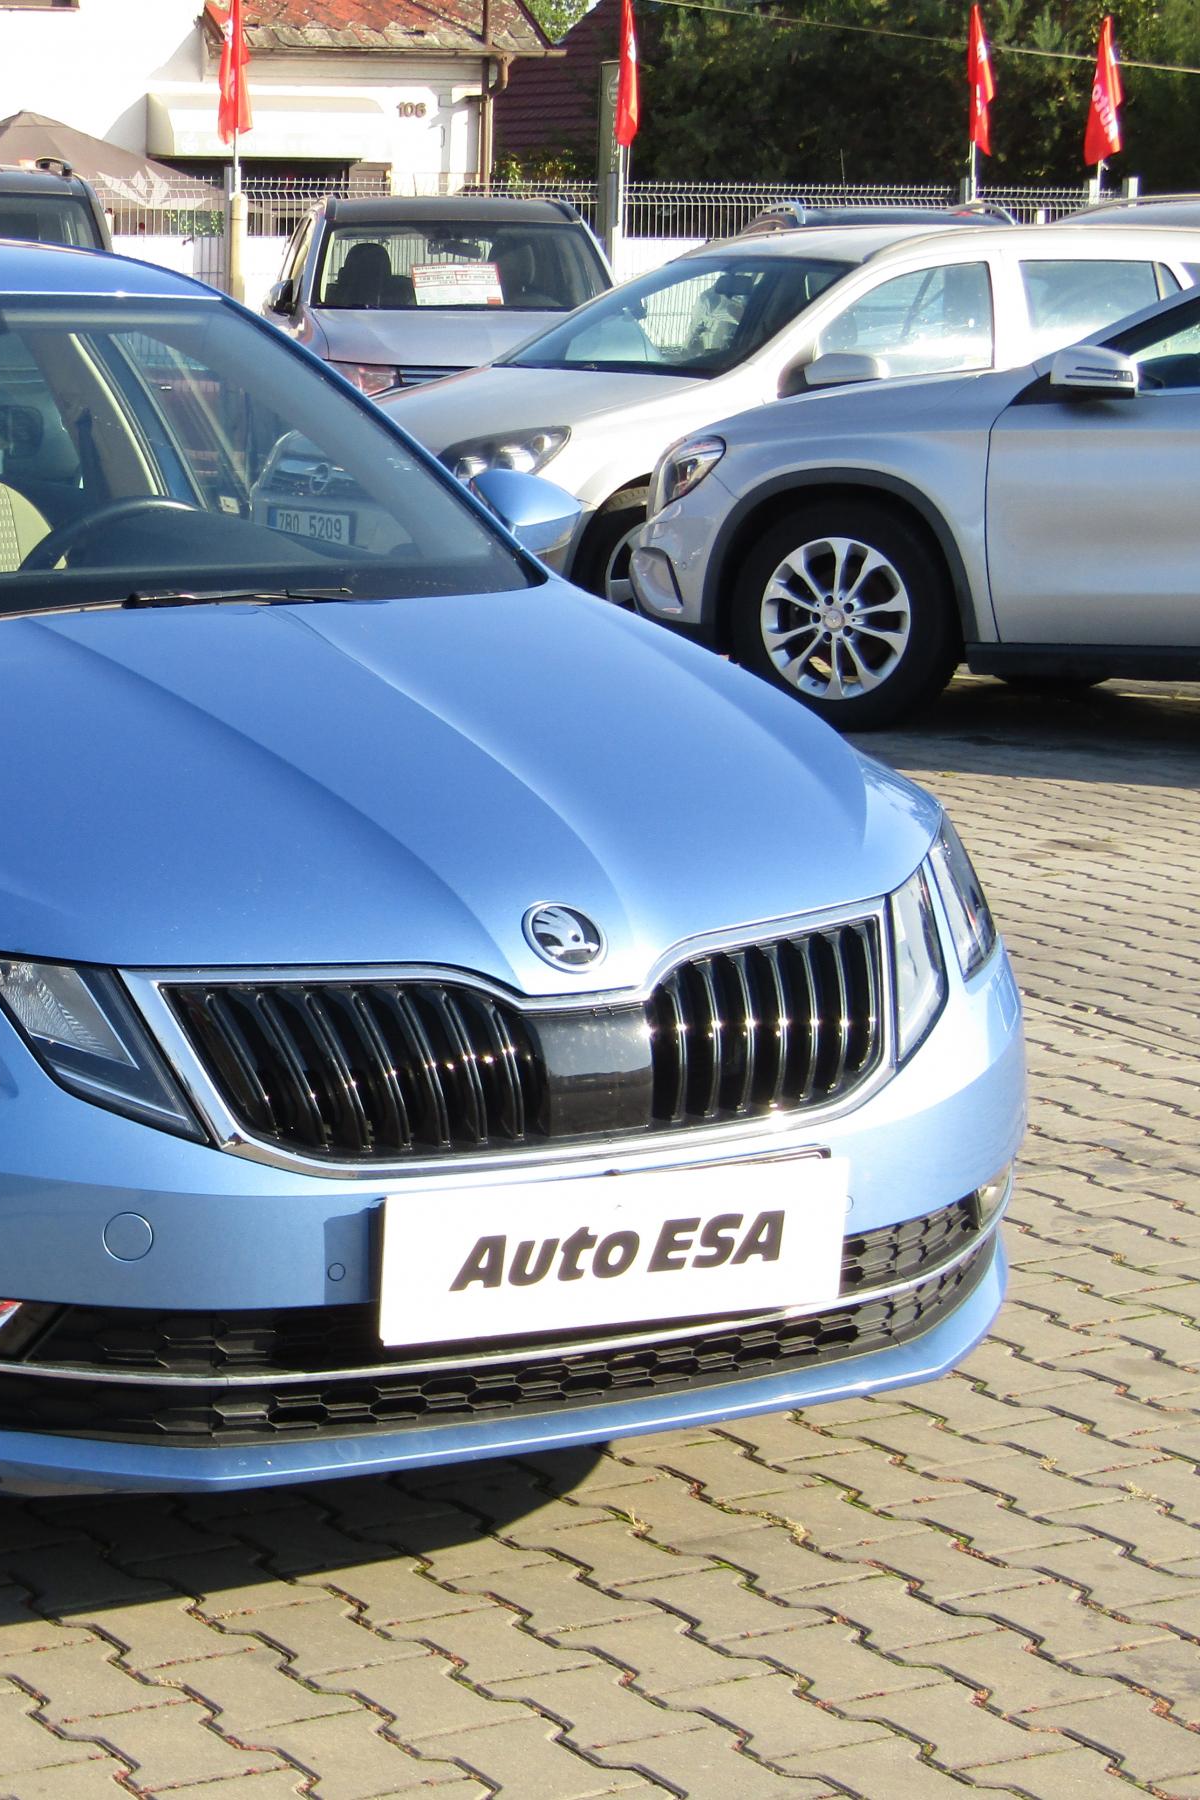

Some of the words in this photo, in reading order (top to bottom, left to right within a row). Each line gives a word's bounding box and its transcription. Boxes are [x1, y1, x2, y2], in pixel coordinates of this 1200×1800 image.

[396, 102, 427, 118] 106
[309, 515, 342, 541] 5209
[449, 1226, 640, 1292] Auto
[647, 1210, 785, 1273] ESA
